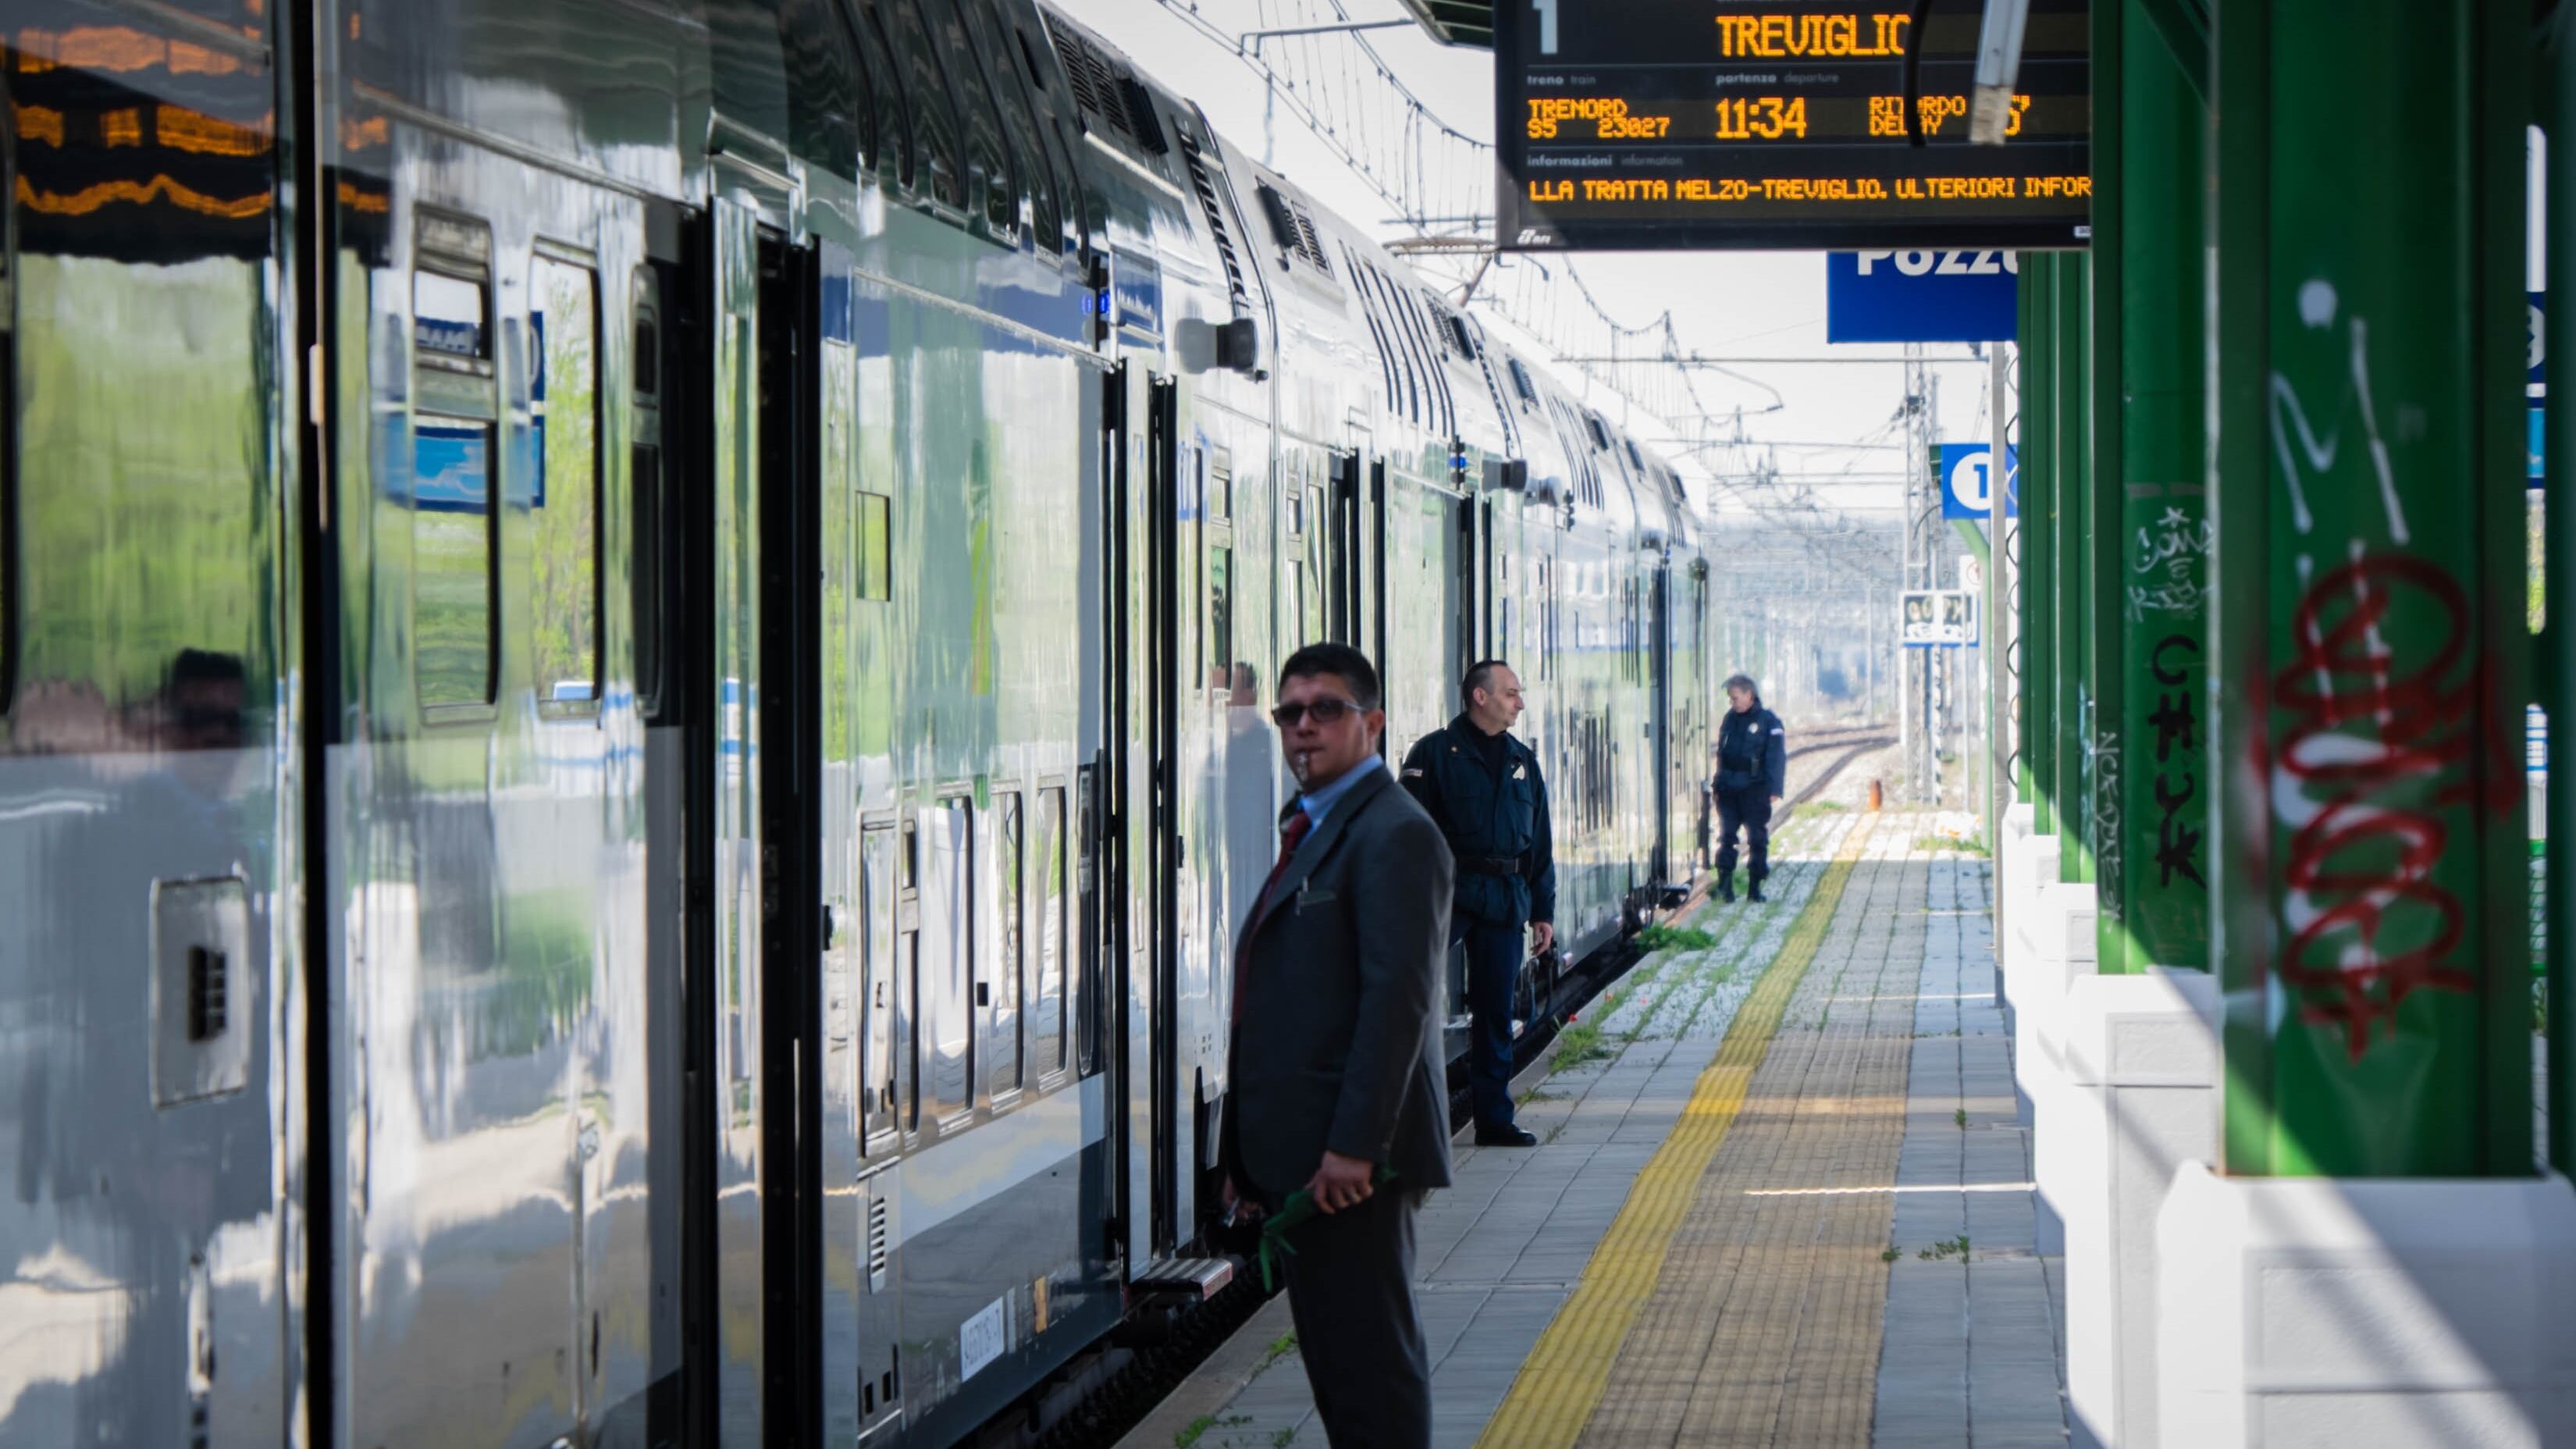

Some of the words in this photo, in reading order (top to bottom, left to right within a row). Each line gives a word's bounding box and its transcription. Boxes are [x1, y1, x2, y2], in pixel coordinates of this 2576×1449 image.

[1532, 0, 1557, 54] 1
[1527, 75, 1564, 85] treno
[1570, 75, 1596, 85] train
[1715, 73, 1777, 87] partenza
[1784, 71, 1840, 87] departure
[1528, 98, 1628, 119] TRENORD
[1716, 97, 1808, 139] 11:34
[1597, 116, 1671, 138] 23027
[1527, 155, 1614, 167] informazioni
[1621, 154, 1684, 167] information
[1528, 180, 1574, 201] LLA
[1582, 179, 1668, 201] TRATTA
[1895, 176, 2016, 199] ULTERIORI
